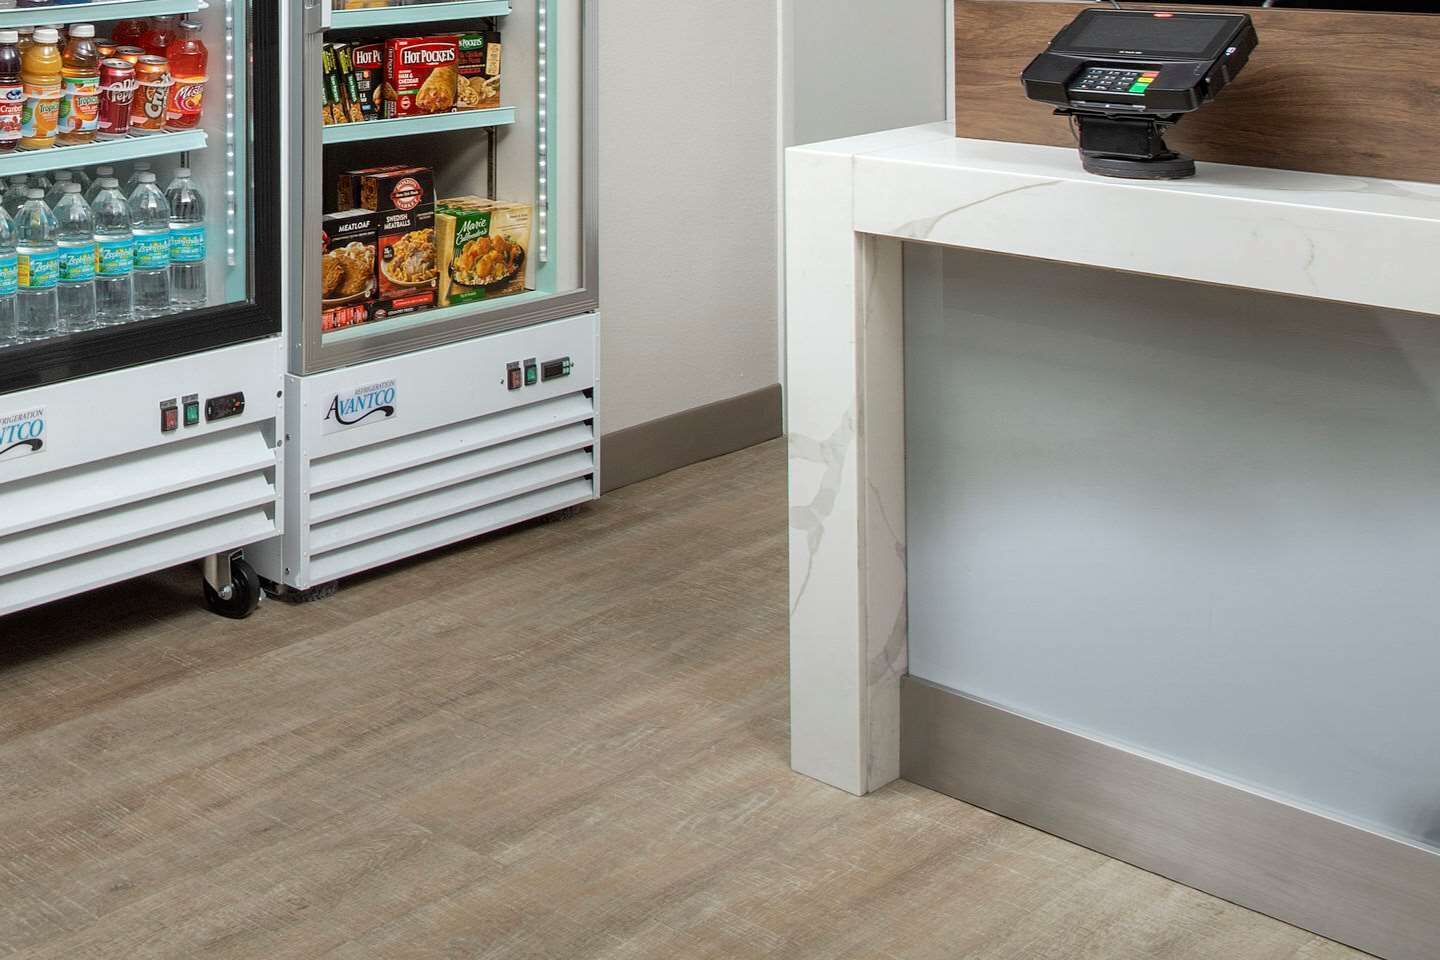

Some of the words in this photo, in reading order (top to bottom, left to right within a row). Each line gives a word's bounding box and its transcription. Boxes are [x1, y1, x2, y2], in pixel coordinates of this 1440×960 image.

[356, 50, 371, 64] HOT
[404, 50, 420, 64] HOT
[421, 47, 455, 62] POCKETS
[384, 220, 411, 230] MEATBALLS
[386, 214, 408, 223] SWEDISH
[338, 220, 370, 233] MEATLOAF
[461, 218, 488, 235] Marie
[324, 387, 395, 425] AVANTCO
